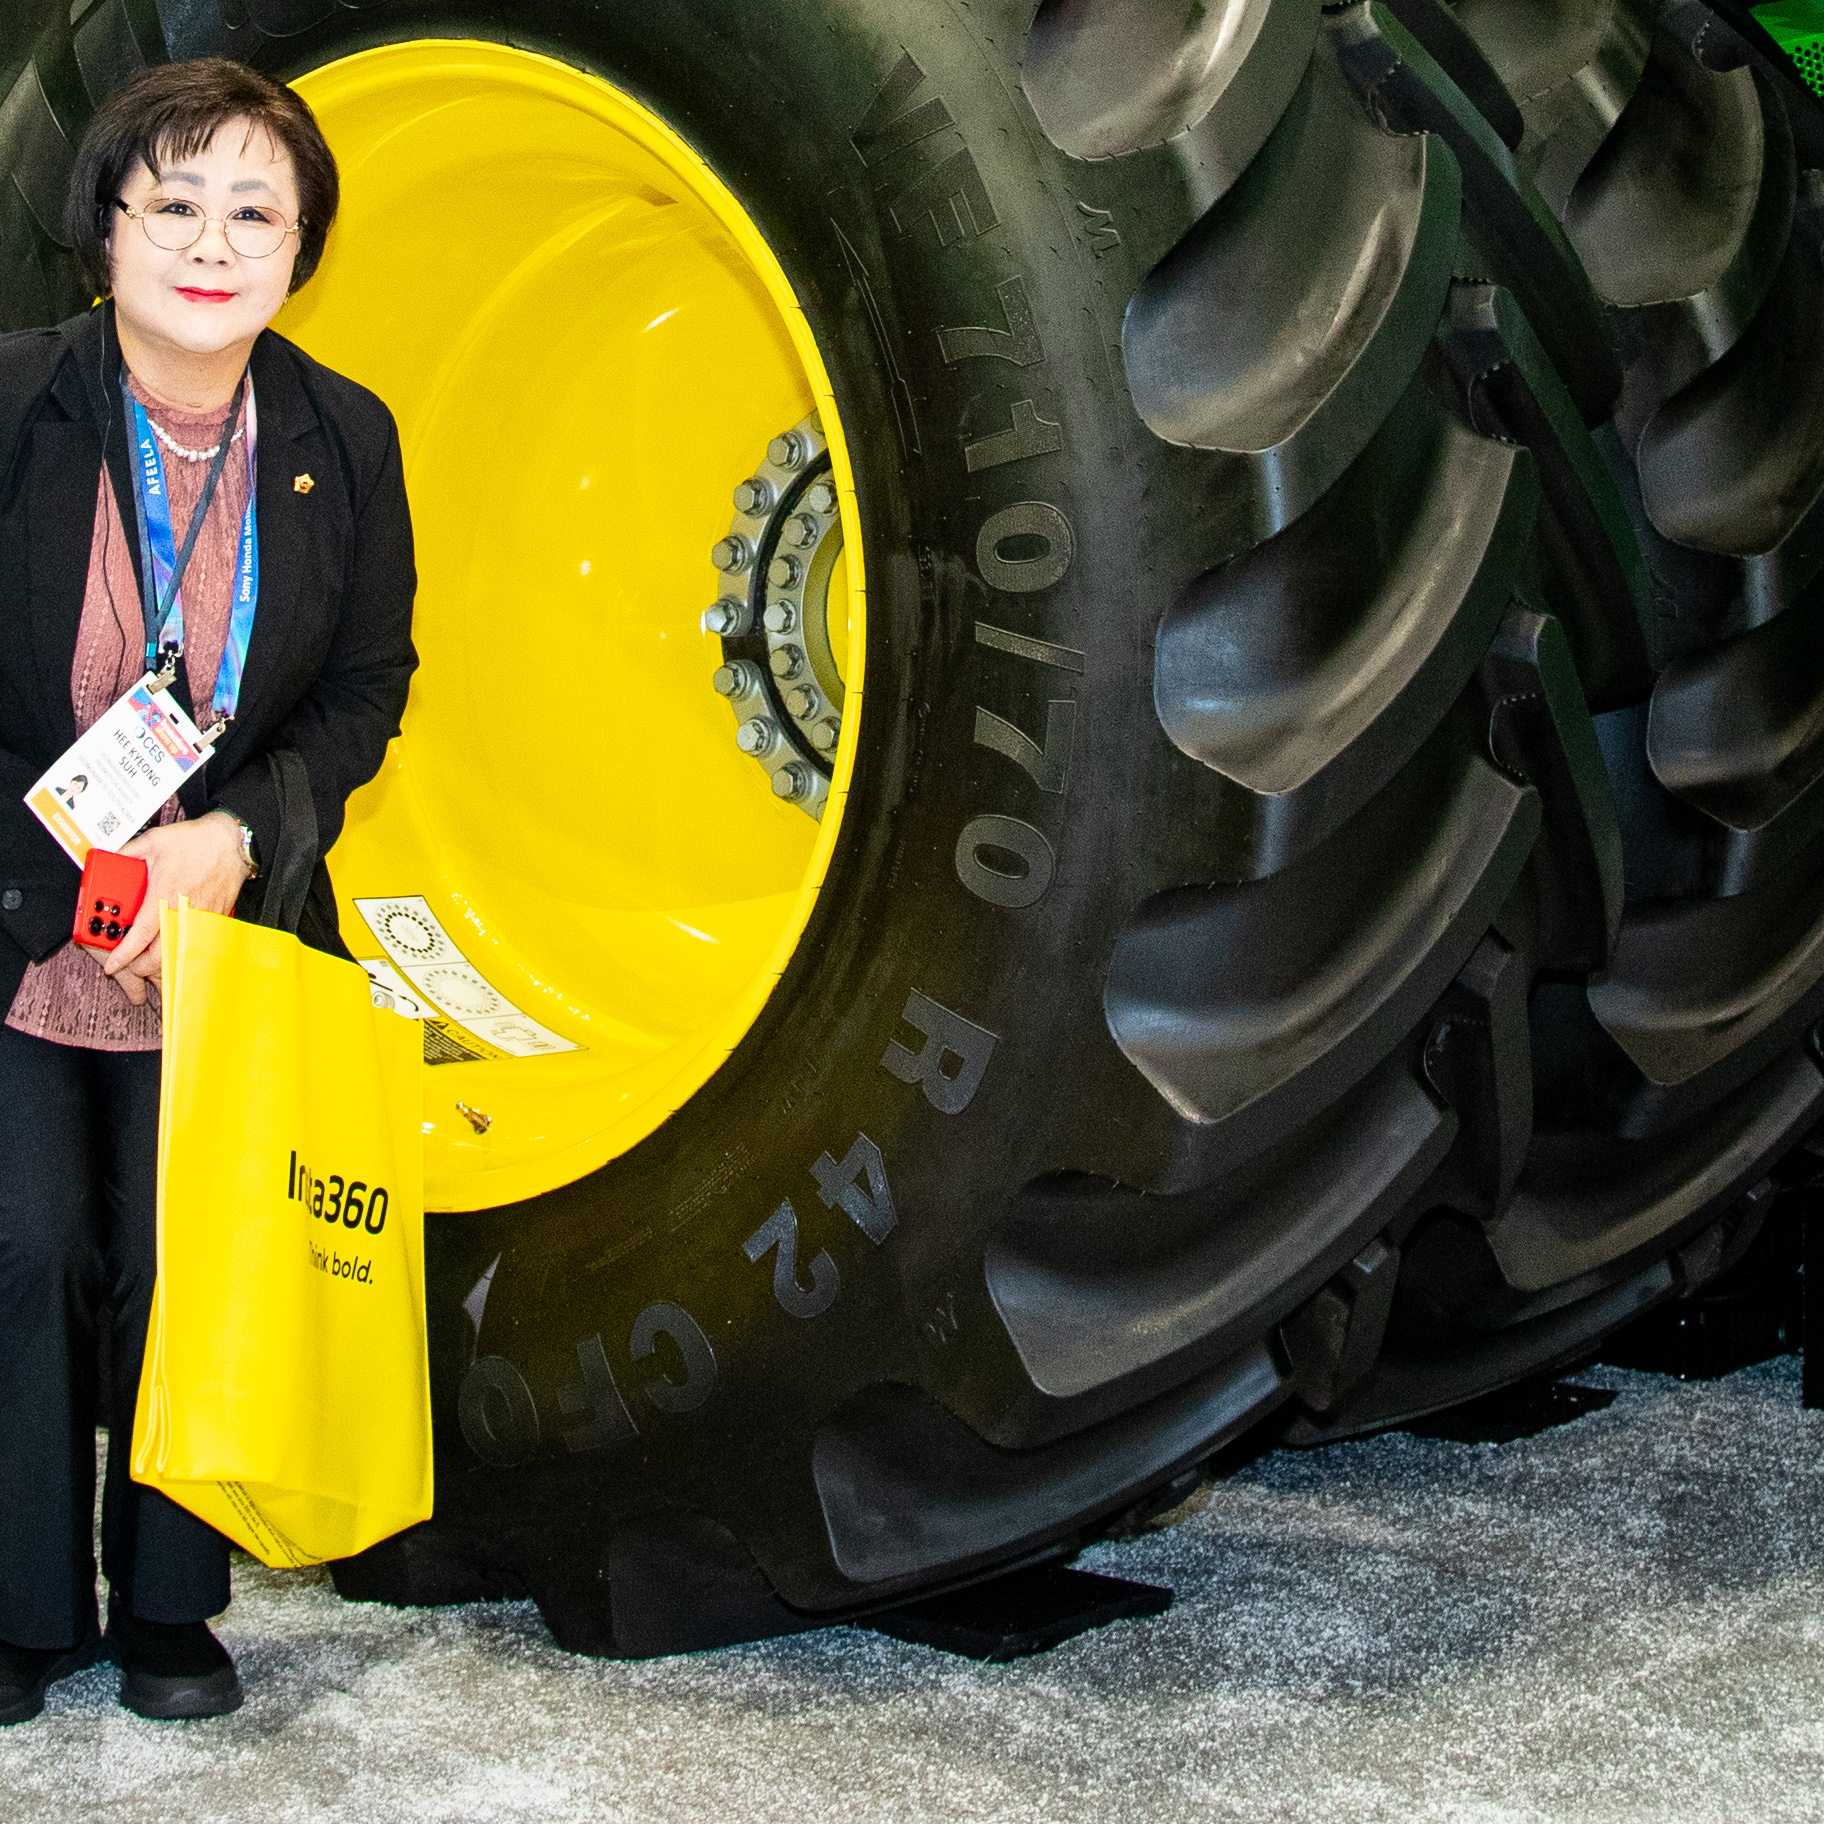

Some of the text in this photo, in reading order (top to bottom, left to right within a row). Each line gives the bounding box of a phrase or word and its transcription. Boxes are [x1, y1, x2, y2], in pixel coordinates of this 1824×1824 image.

[140, 438, 162, 496] AFEELA
[241, 537, 253, 575] Honda
[239, 575, 255, 603] Sony
[933, 273, 1087, 910] 710/70
[113, 729, 162, 787] HEE KYEONG
[118, 756, 138, 778] SUH
[141, 735, 167, 763] CES
[879, 985, 1002, 1115] R
[287, 1149, 389, 1236] Ina360
[741, 1131, 898, 1319] 42
[331, 1250, 373, 1286] bold.
